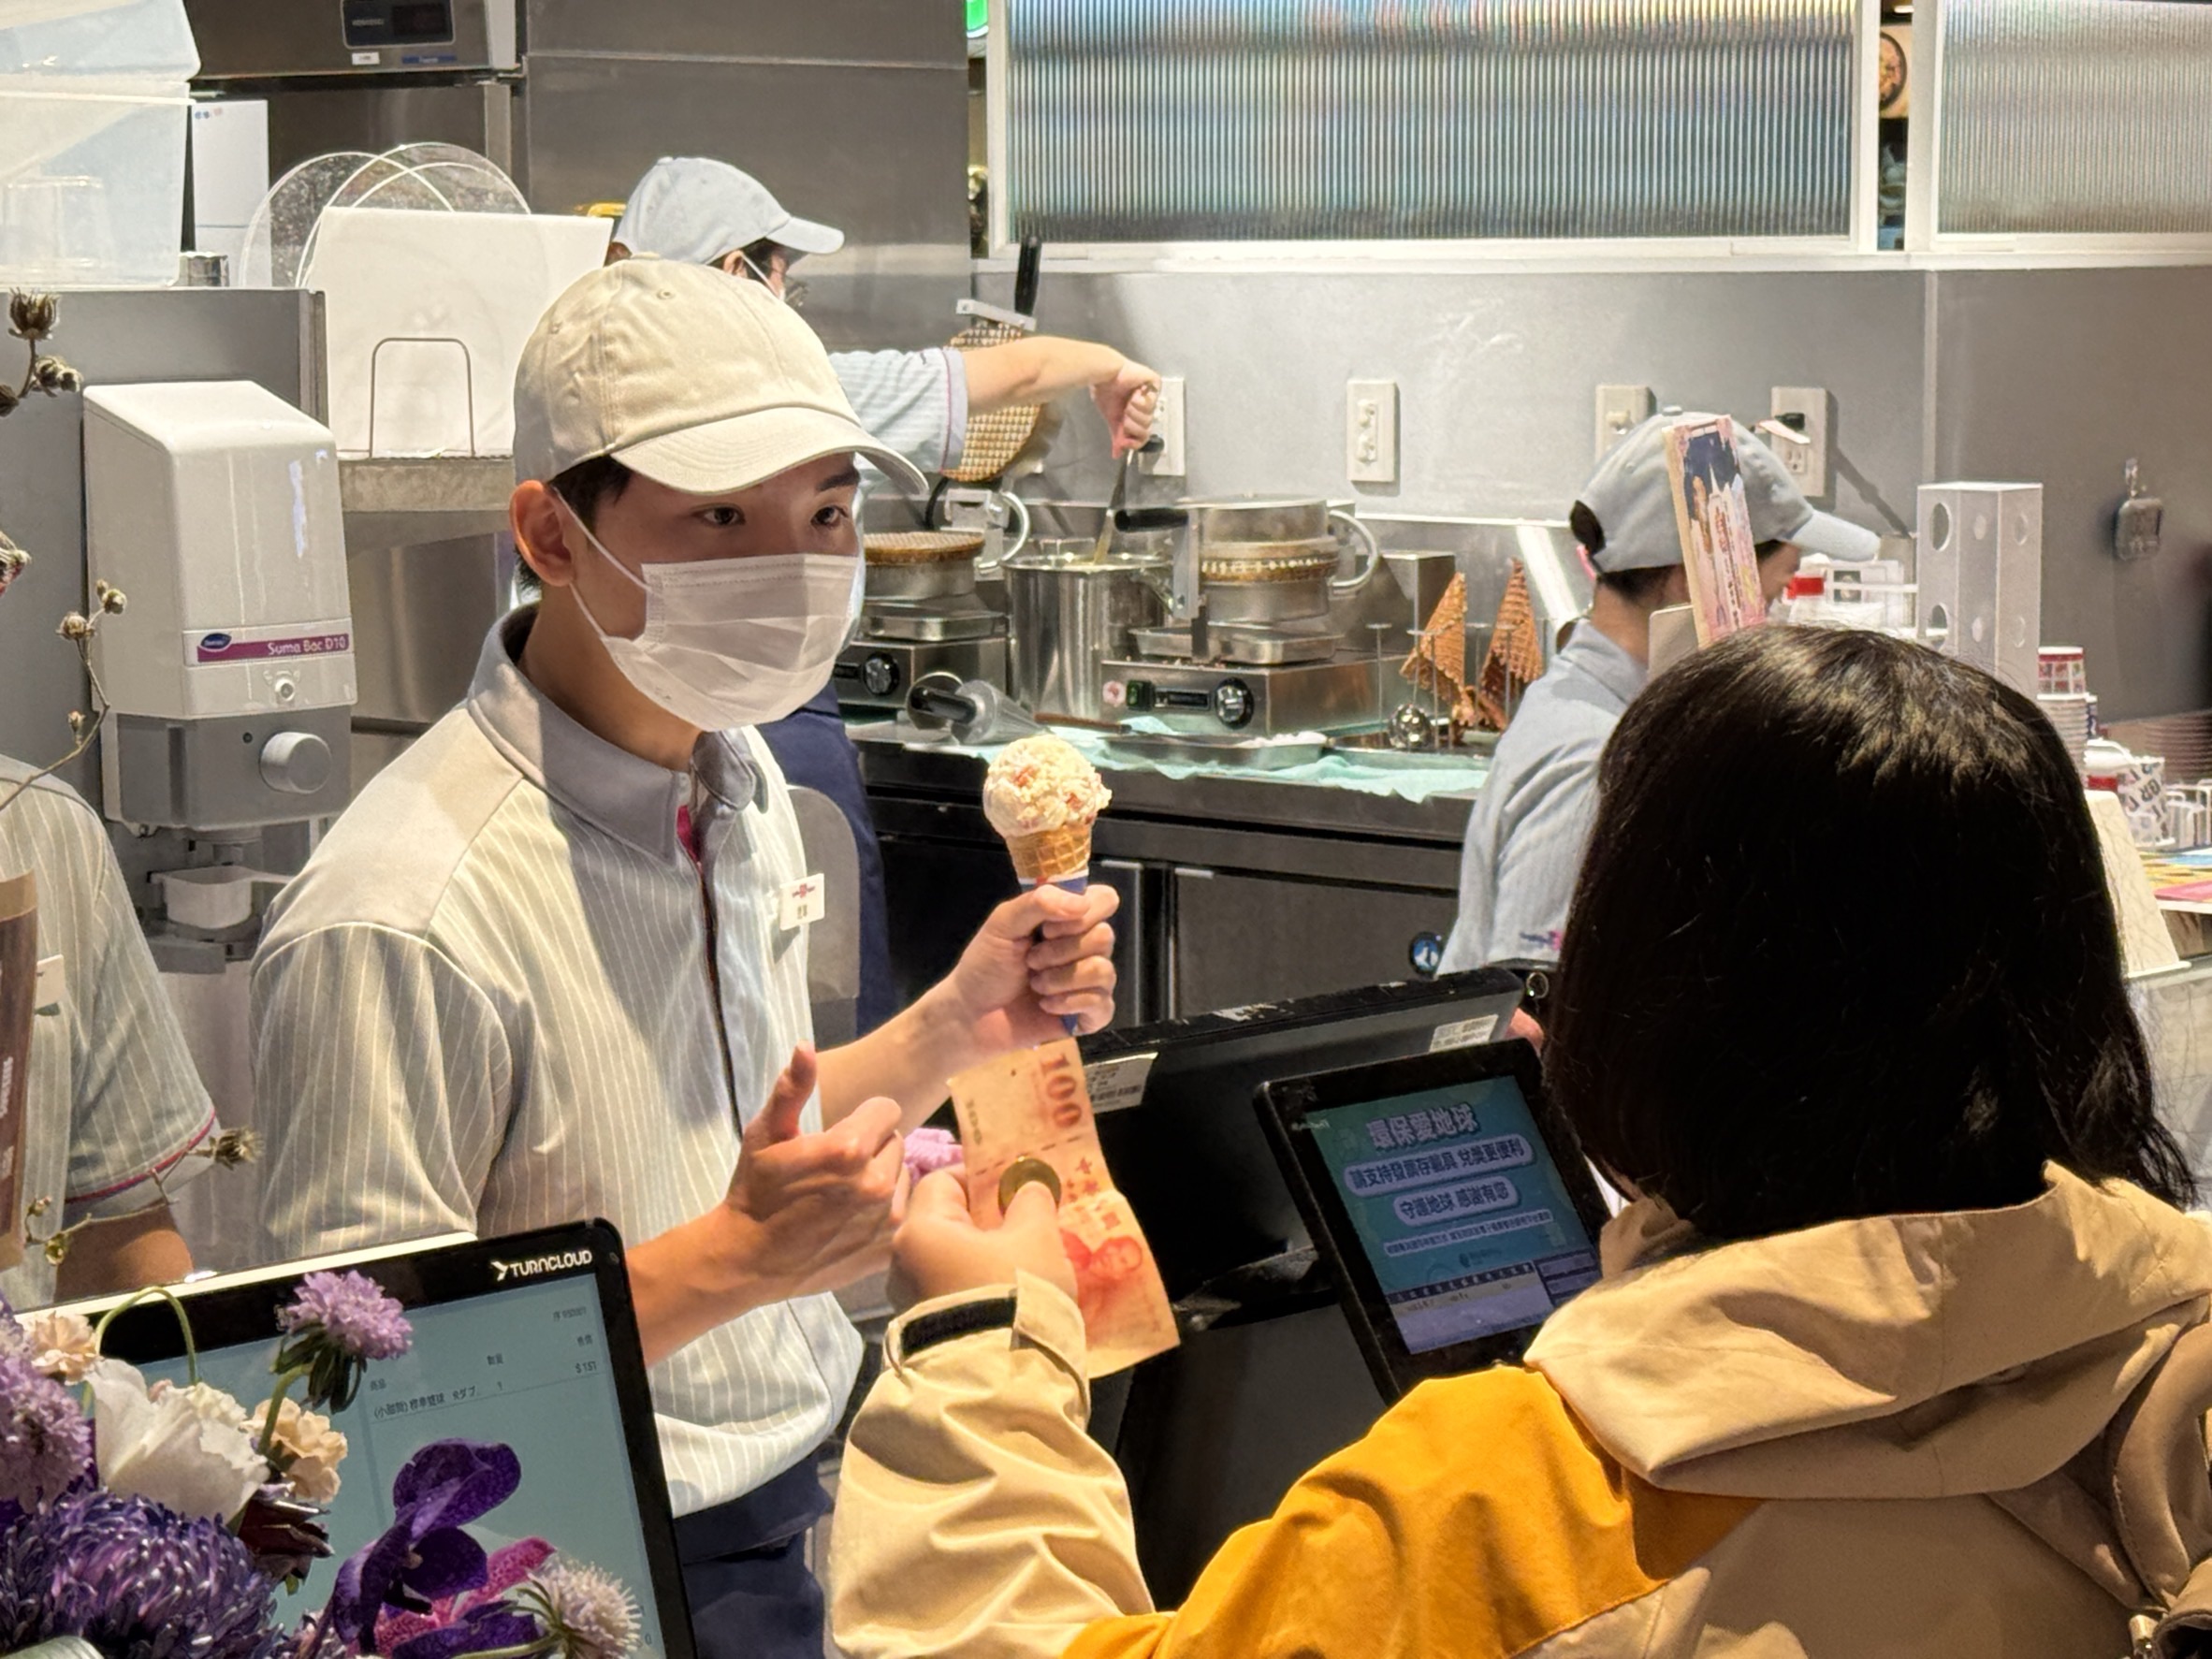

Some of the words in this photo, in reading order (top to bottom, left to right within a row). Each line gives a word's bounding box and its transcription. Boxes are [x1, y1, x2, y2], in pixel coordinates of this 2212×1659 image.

[268, 642, 300, 656] Suma
[325, 636, 346, 650] D10
[1041, 1054, 1082, 1128] 100
[1366, 1102, 1478, 1149] 環保愛地球
[1399, 1192, 1455, 1220] 守護地球
[1454, 1181, 1509, 1209] 感謝有您
[509, 1249, 593, 1278] TURNCLOUD
